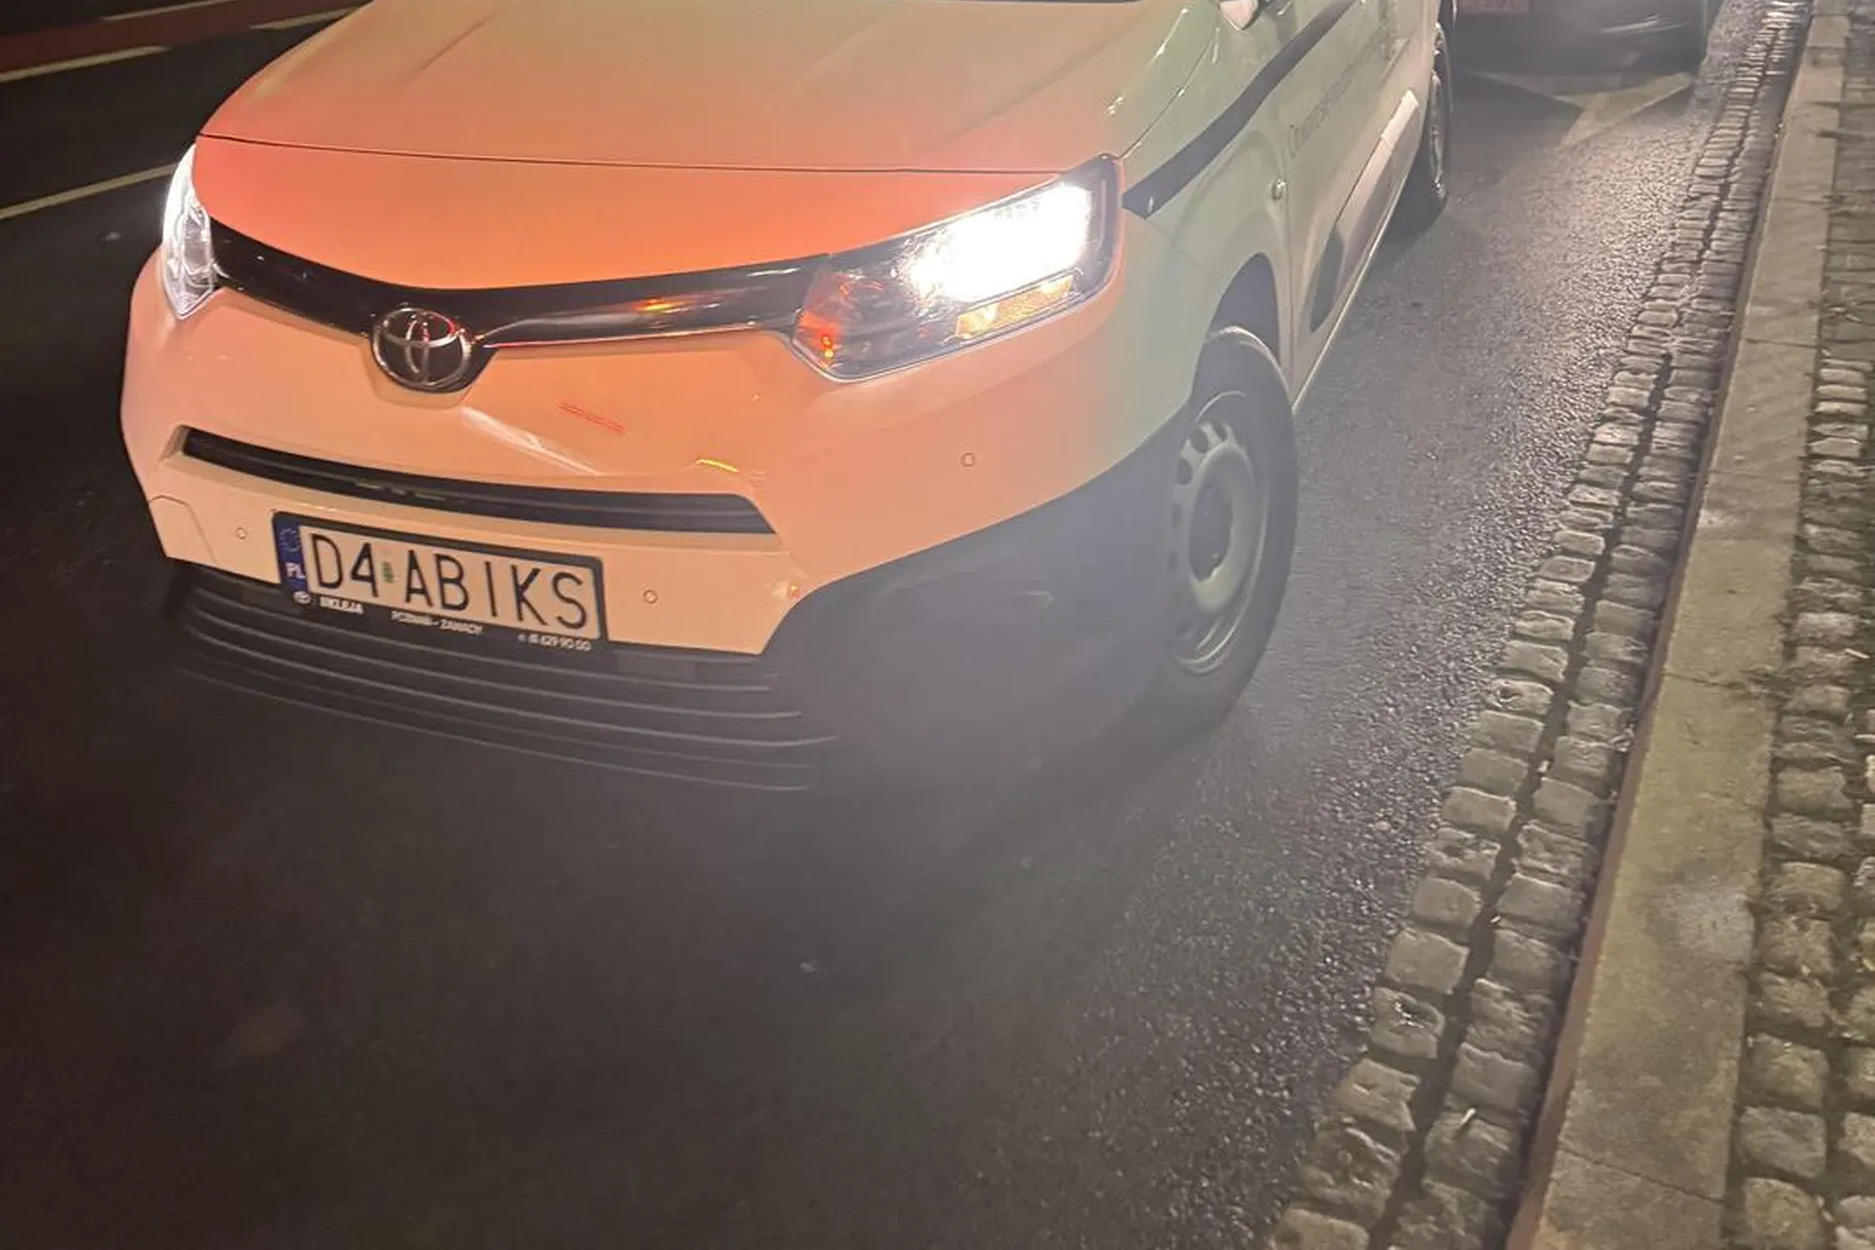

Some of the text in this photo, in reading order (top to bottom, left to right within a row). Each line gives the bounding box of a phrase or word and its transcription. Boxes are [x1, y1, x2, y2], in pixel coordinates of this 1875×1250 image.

[286, 562, 306, 579] PL
[311, 534, 588, 629] D4 ABIKS
